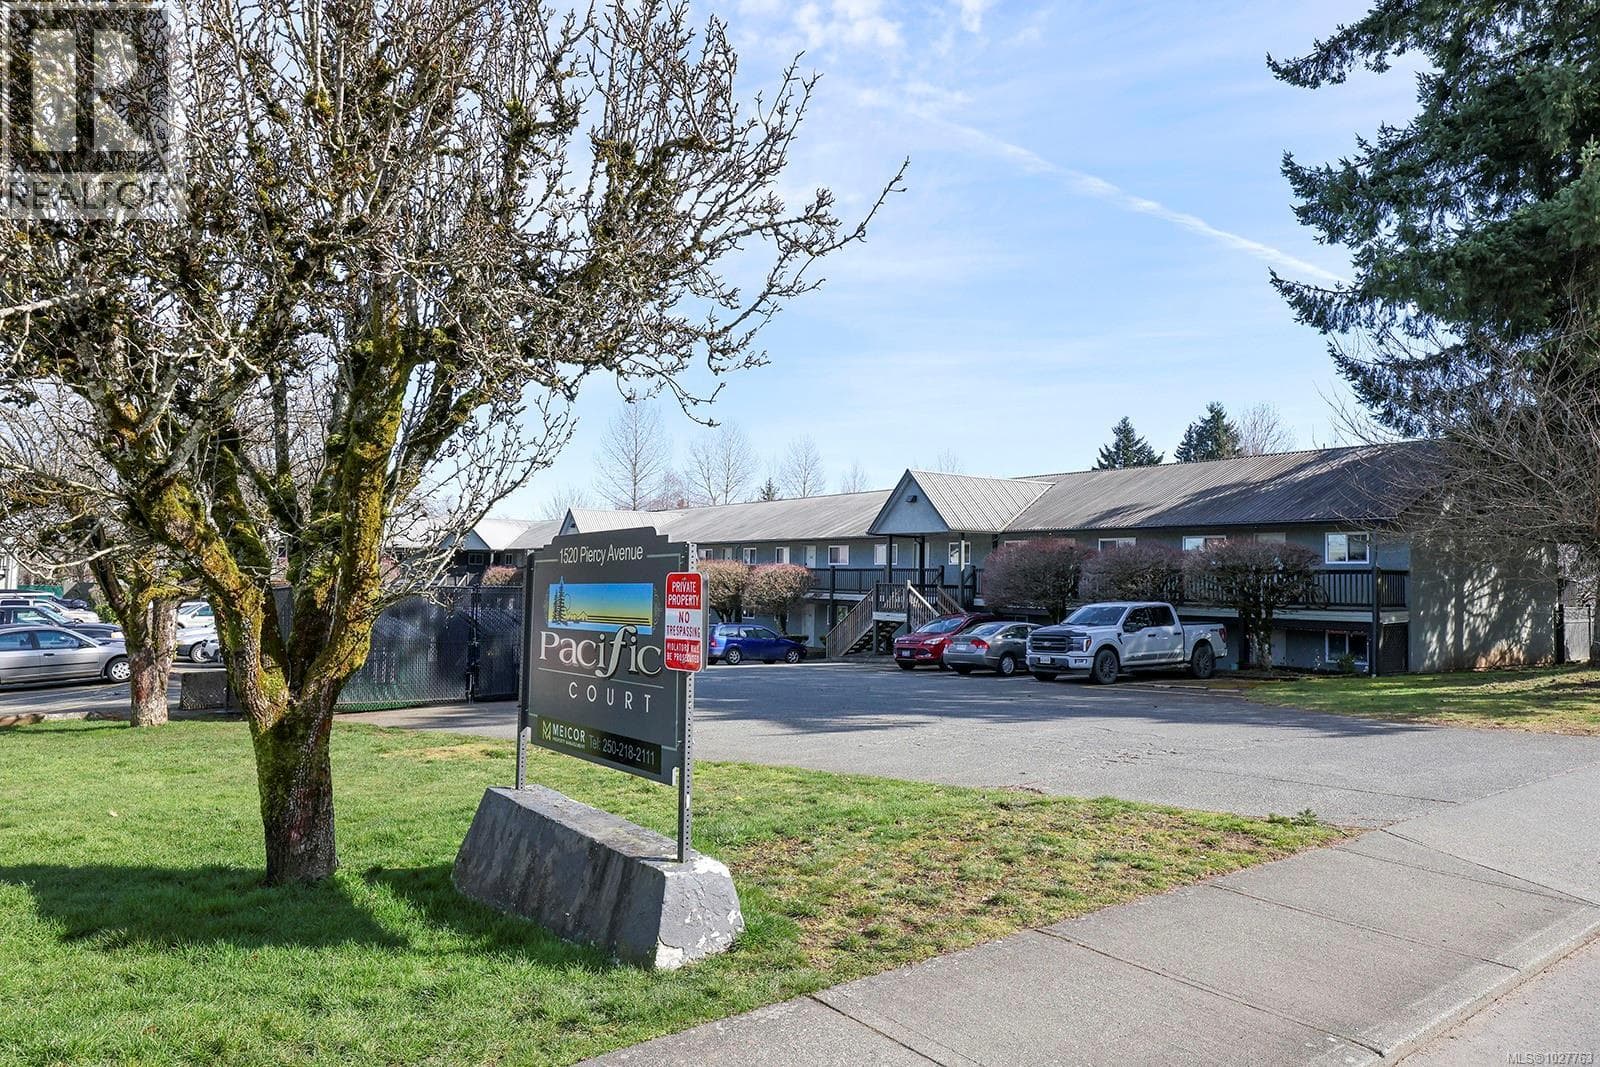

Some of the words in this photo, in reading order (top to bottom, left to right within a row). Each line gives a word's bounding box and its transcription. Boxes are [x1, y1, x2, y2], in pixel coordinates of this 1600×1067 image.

[559, 549, 577, 564] 1520
[580, 546, 606, 566] Piercy
[607, 544, 643, 561] Avenue
[672, 581, 696, 593] PRIVATE
[668, 594, 699, 606] PROPERTY
[678, 611, 690, 623] NO
[666, 624, 701, 638] TRESPASSING
[538, 625, 662, 678] Pacific
[568, 681, 651, 713] COURT
[552, 723, 586, 743] MEICOR
[602, 738, 655, 766] 250-218-2111
